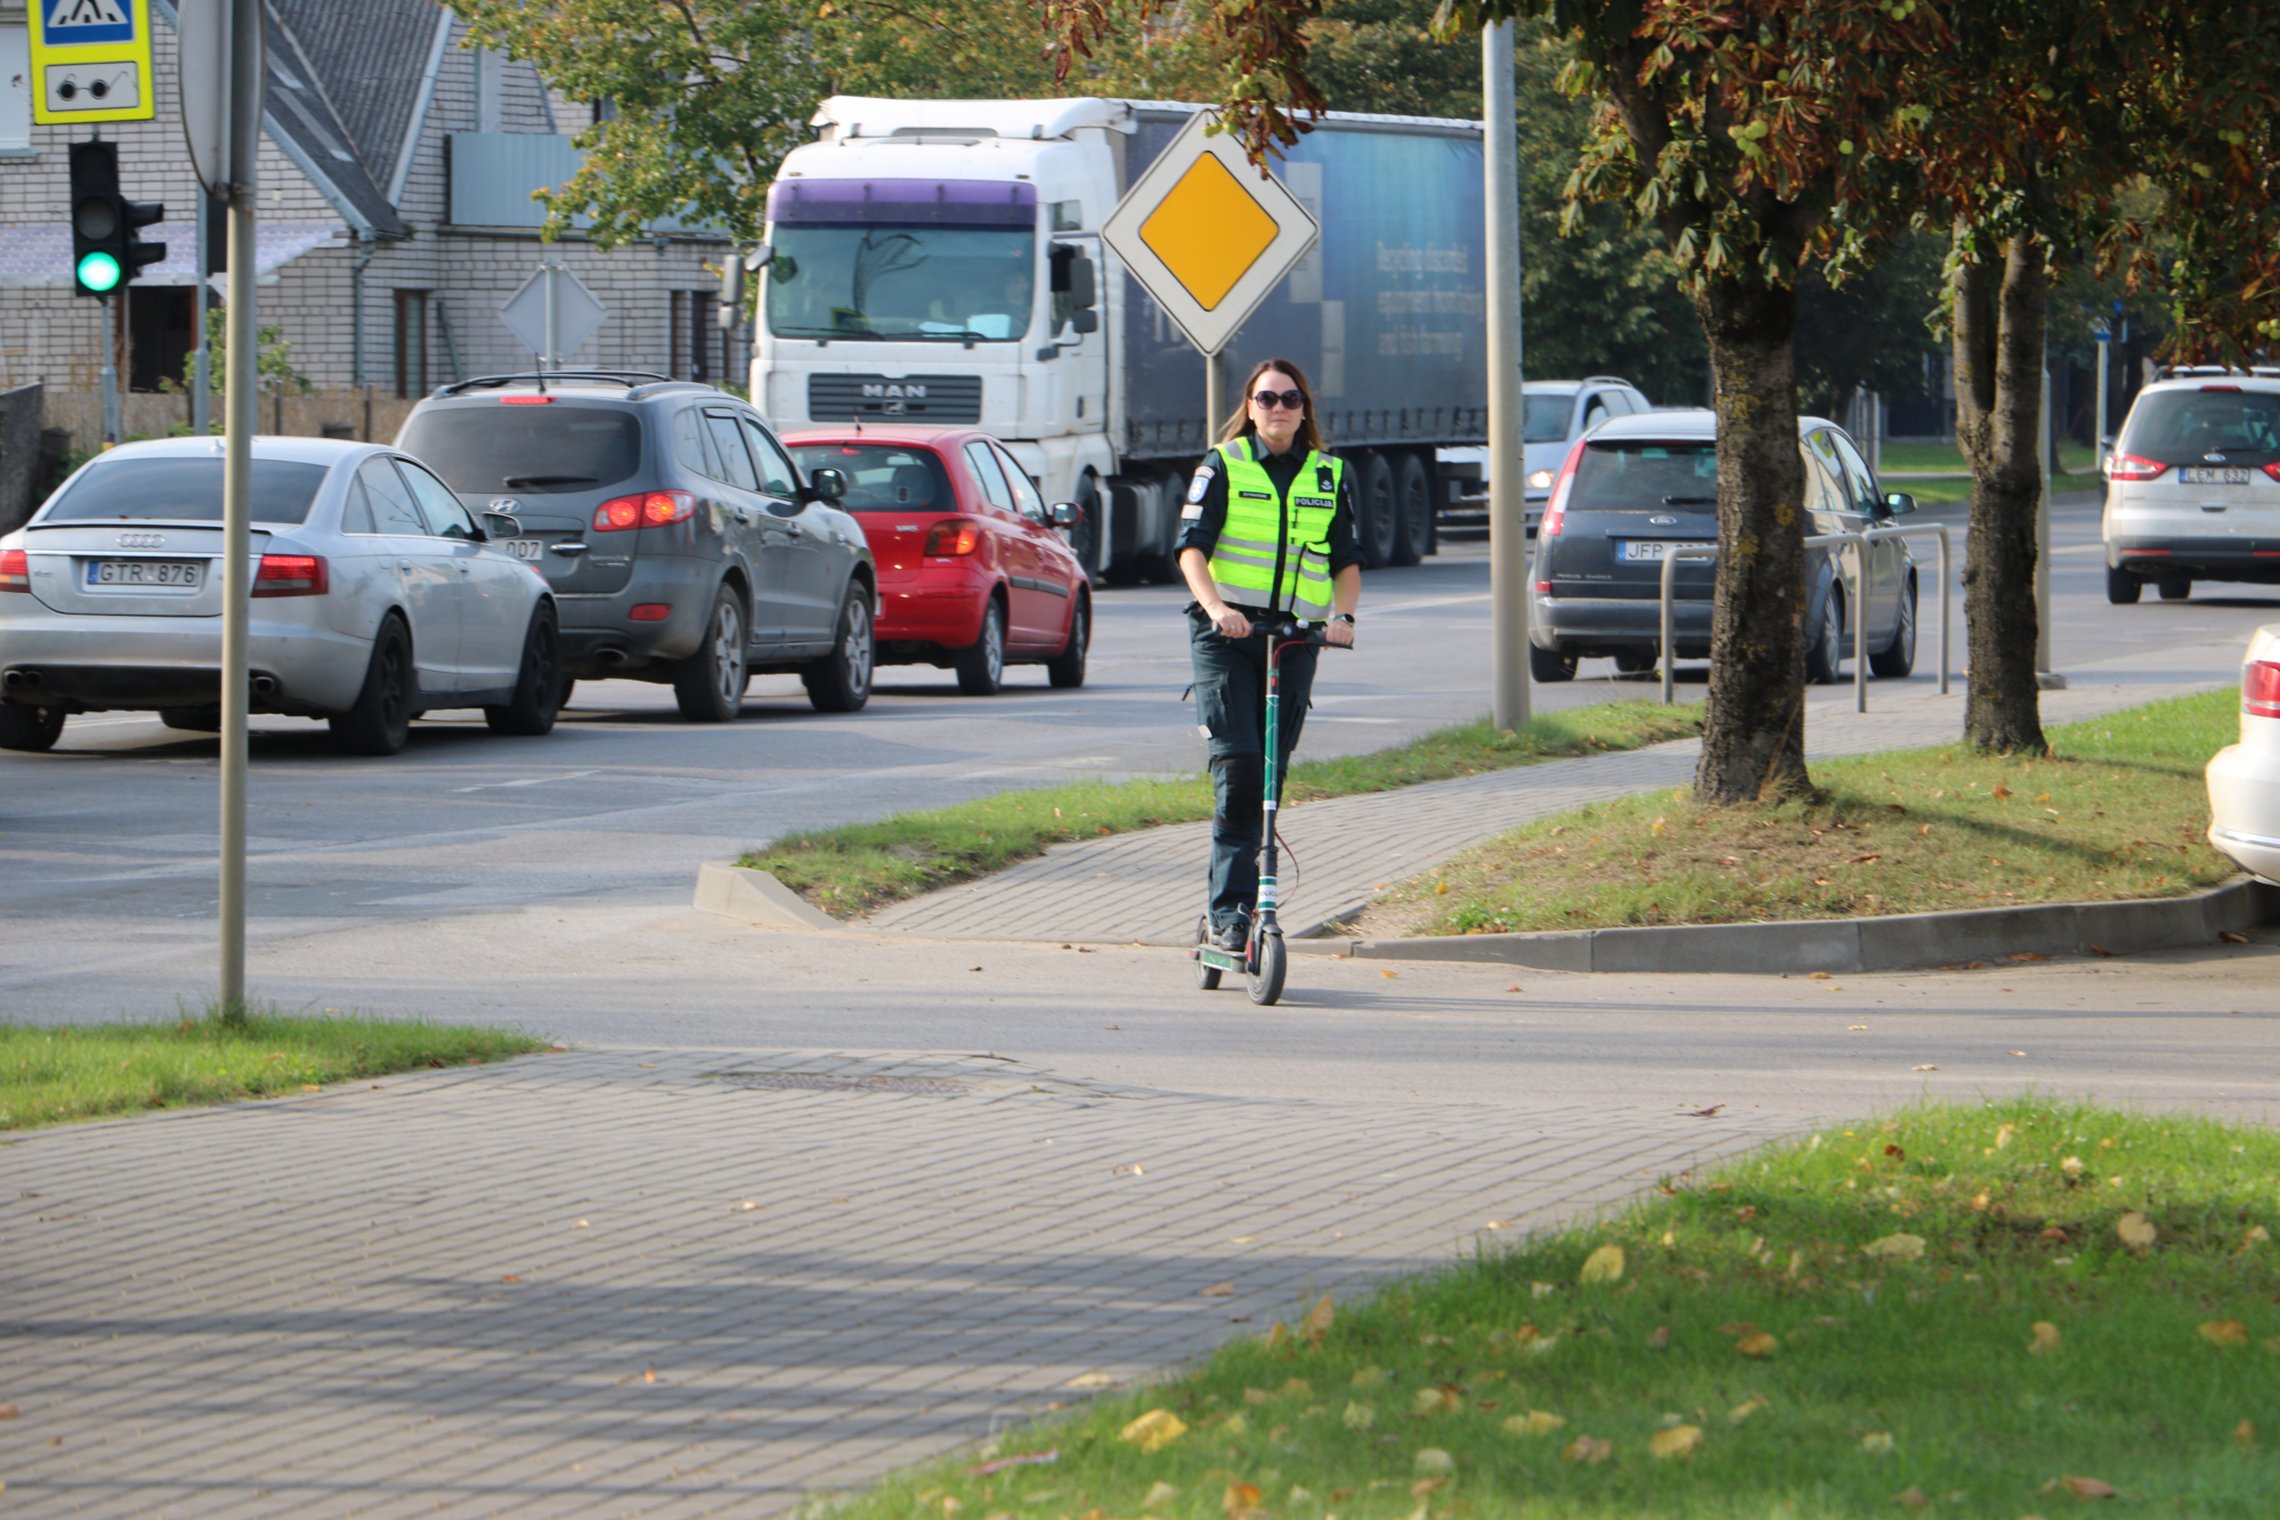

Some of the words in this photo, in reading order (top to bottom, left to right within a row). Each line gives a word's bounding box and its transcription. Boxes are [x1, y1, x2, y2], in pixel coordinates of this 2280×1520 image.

[862, 384, 927, 398] MAN
[1295, 497, 1333, 509] POLICIJA
[1628, 543, 1663, 558] JFP
[100, 564, 143, 582] GTR
[158, 565, 196, 583] 876
